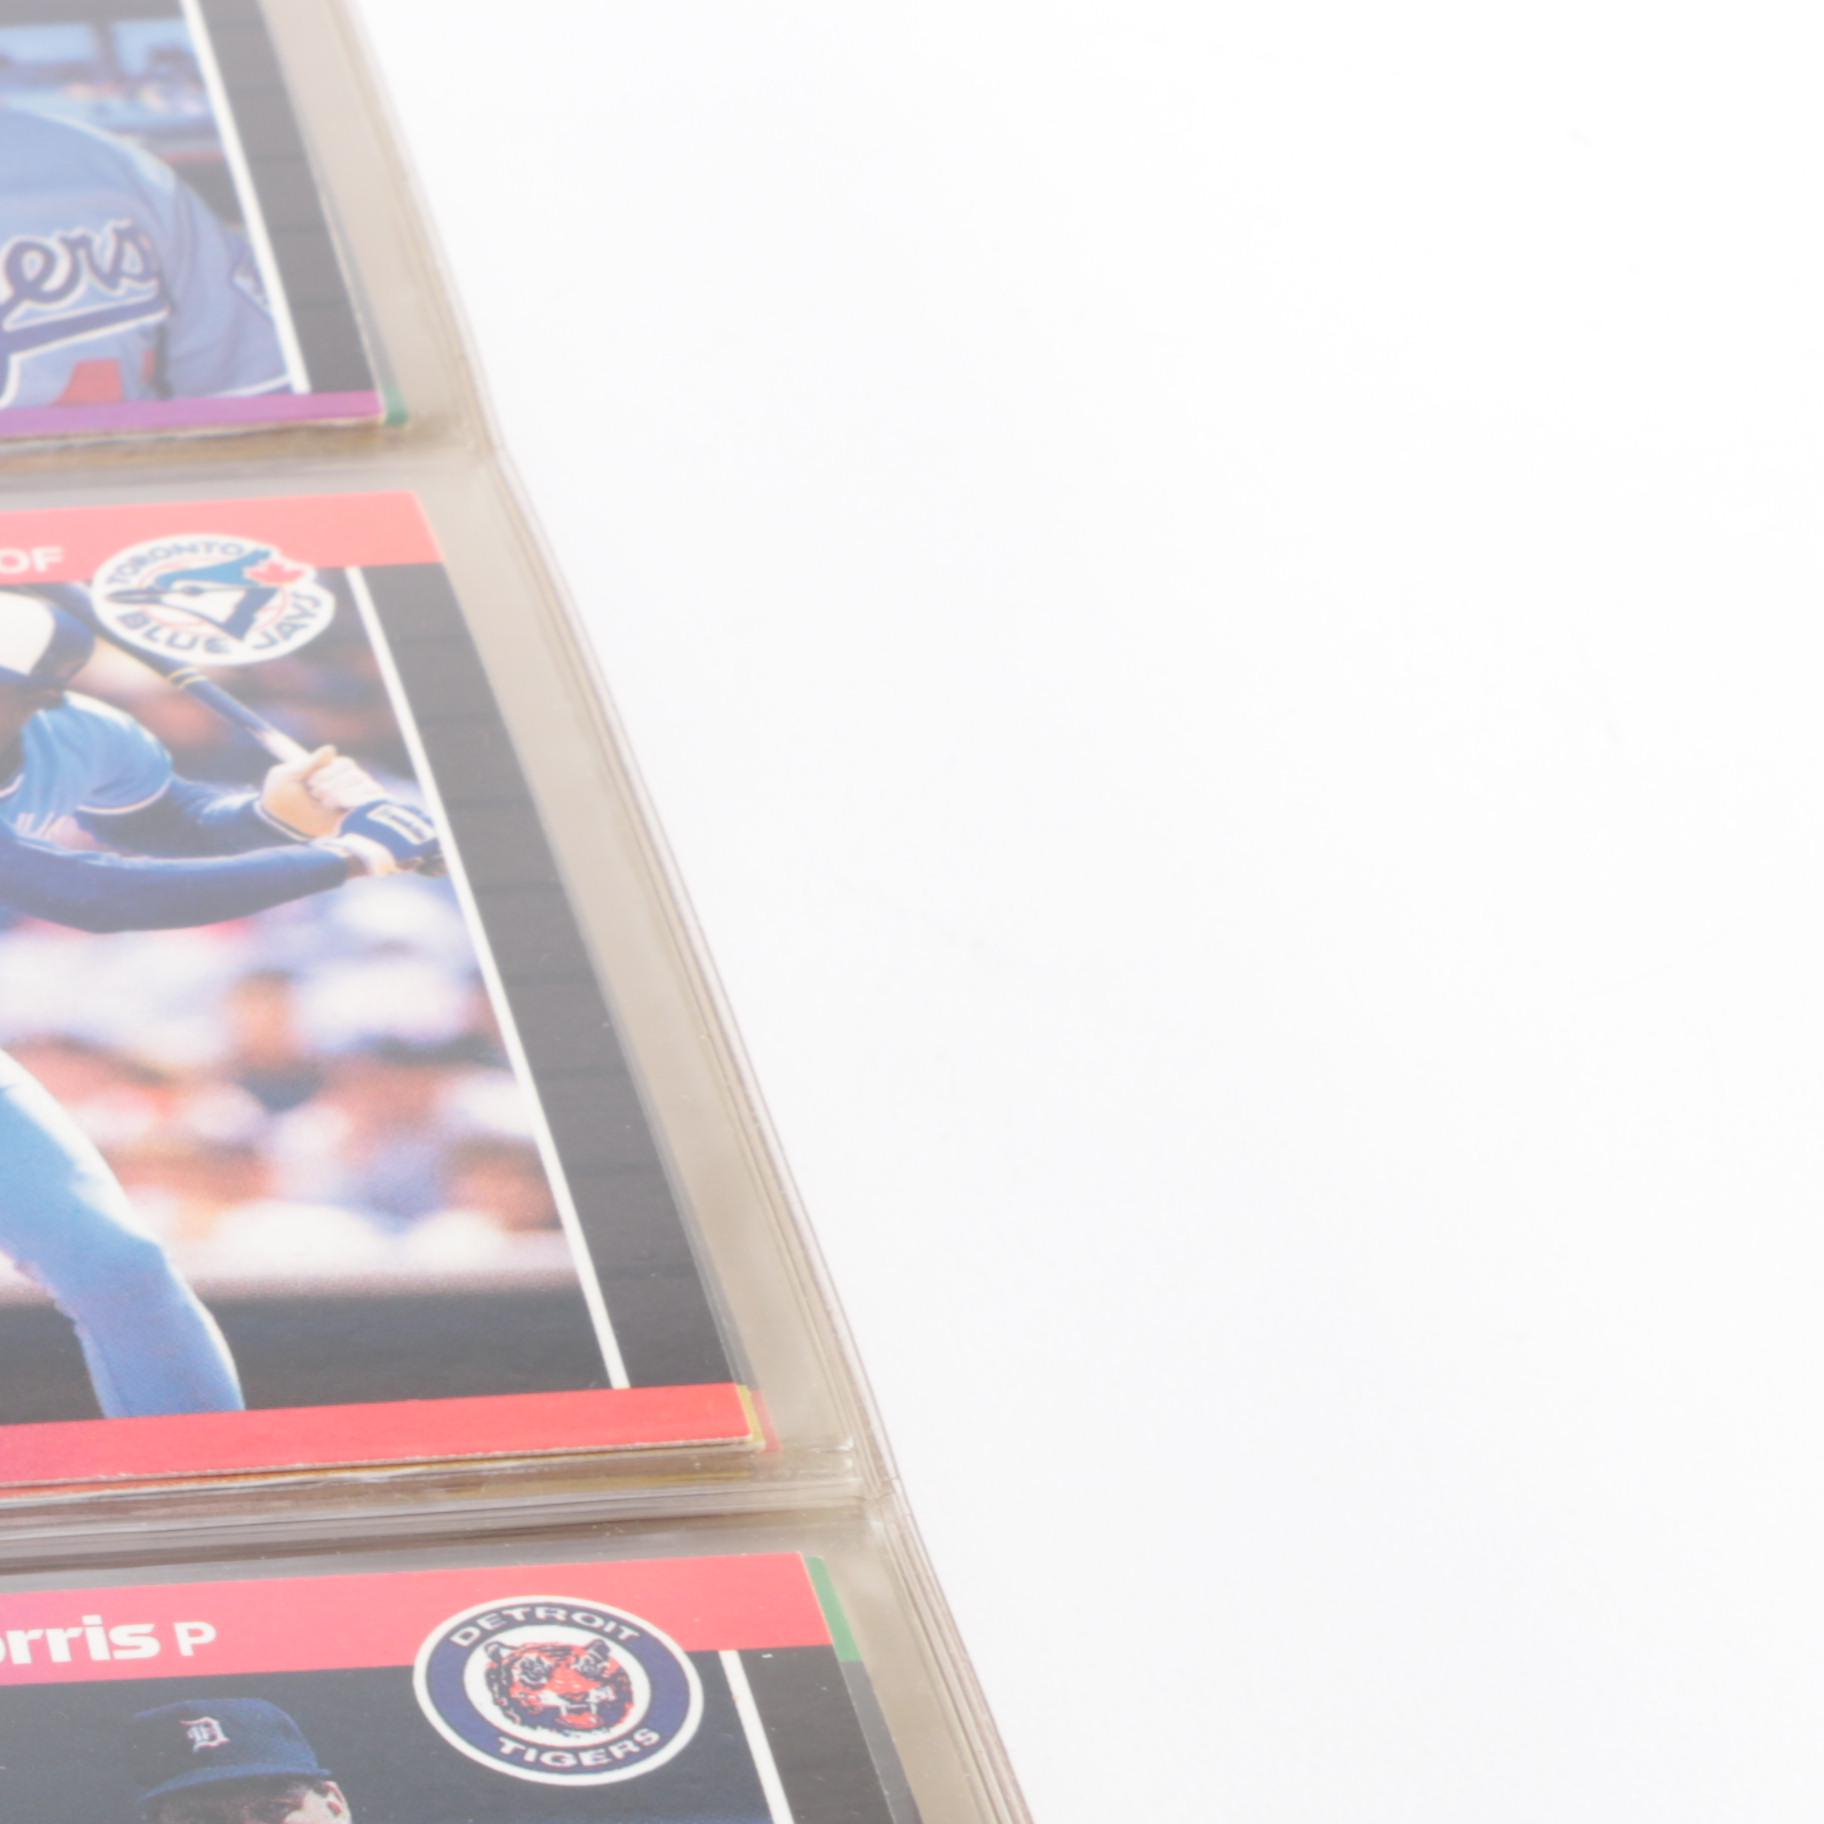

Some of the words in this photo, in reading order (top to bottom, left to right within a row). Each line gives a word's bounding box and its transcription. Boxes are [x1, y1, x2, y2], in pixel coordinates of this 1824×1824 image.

[107, 540, 245, 586] TORONTO
[251, 590, 323, 650] JAYS
[174, 1620, 217, 1657] P
[449, 1605, 641, 1648] DETROIT
[498, 1727, 661, 1768] TIGERS
